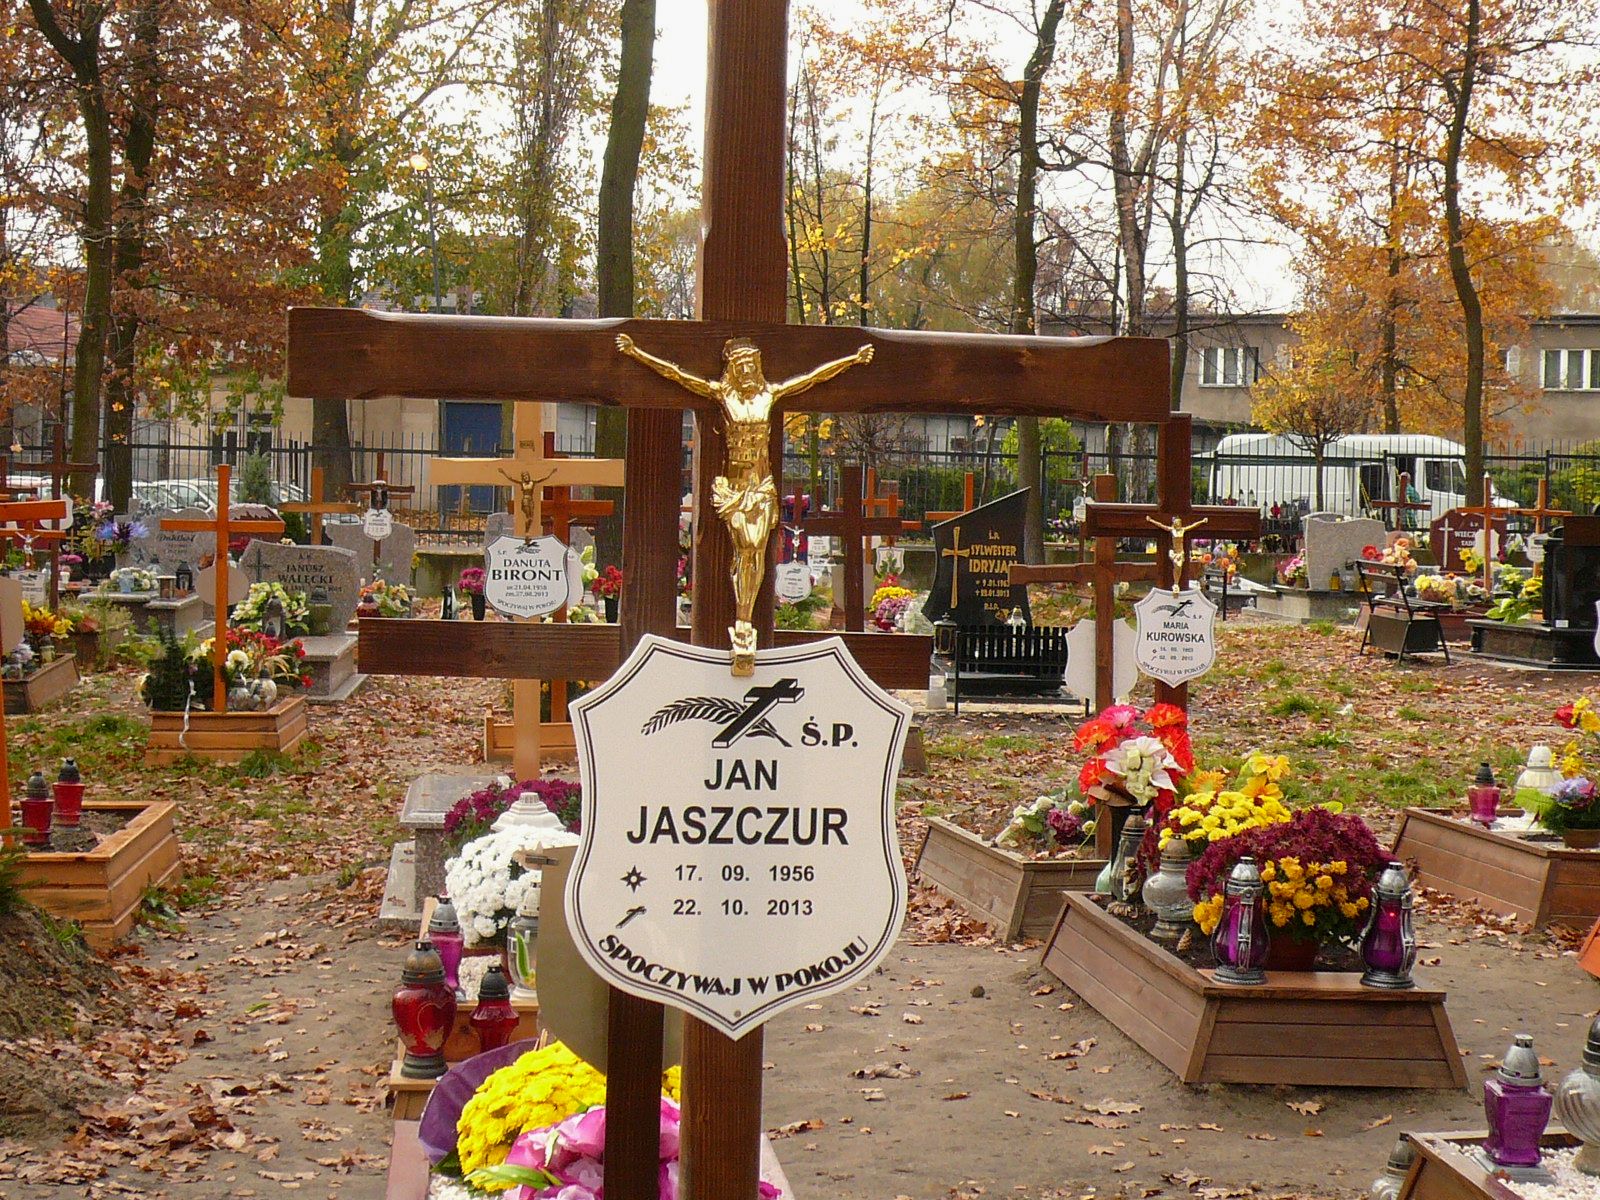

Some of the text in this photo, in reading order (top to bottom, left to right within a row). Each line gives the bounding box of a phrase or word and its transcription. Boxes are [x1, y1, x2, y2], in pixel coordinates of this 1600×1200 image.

[971, 544, 1017, 557] SYLWESTER
[286, 564, 325, 573] JANUSZ
[504, 559, 551, 567] DANUTA
[969, 559, 1018, 573] IDRYJA
[492, 569, 563, 581] BIRONT
[1163, 621, 1190, 630] MARIA
[1146, 632, 1206, 643] KUROWSKA
[801, 716, 858, 747] Ś.P.
[704, 758, 778, 791] JAN
[626, 805, 849, 846] JASZCZUR
[675, 864, 815, 882] 17. 09. 1956
[673, 899, 813, 916] 22. 10. 2013
[599, 935, 868, 995] SPOCZYWAJ W POKOJU
